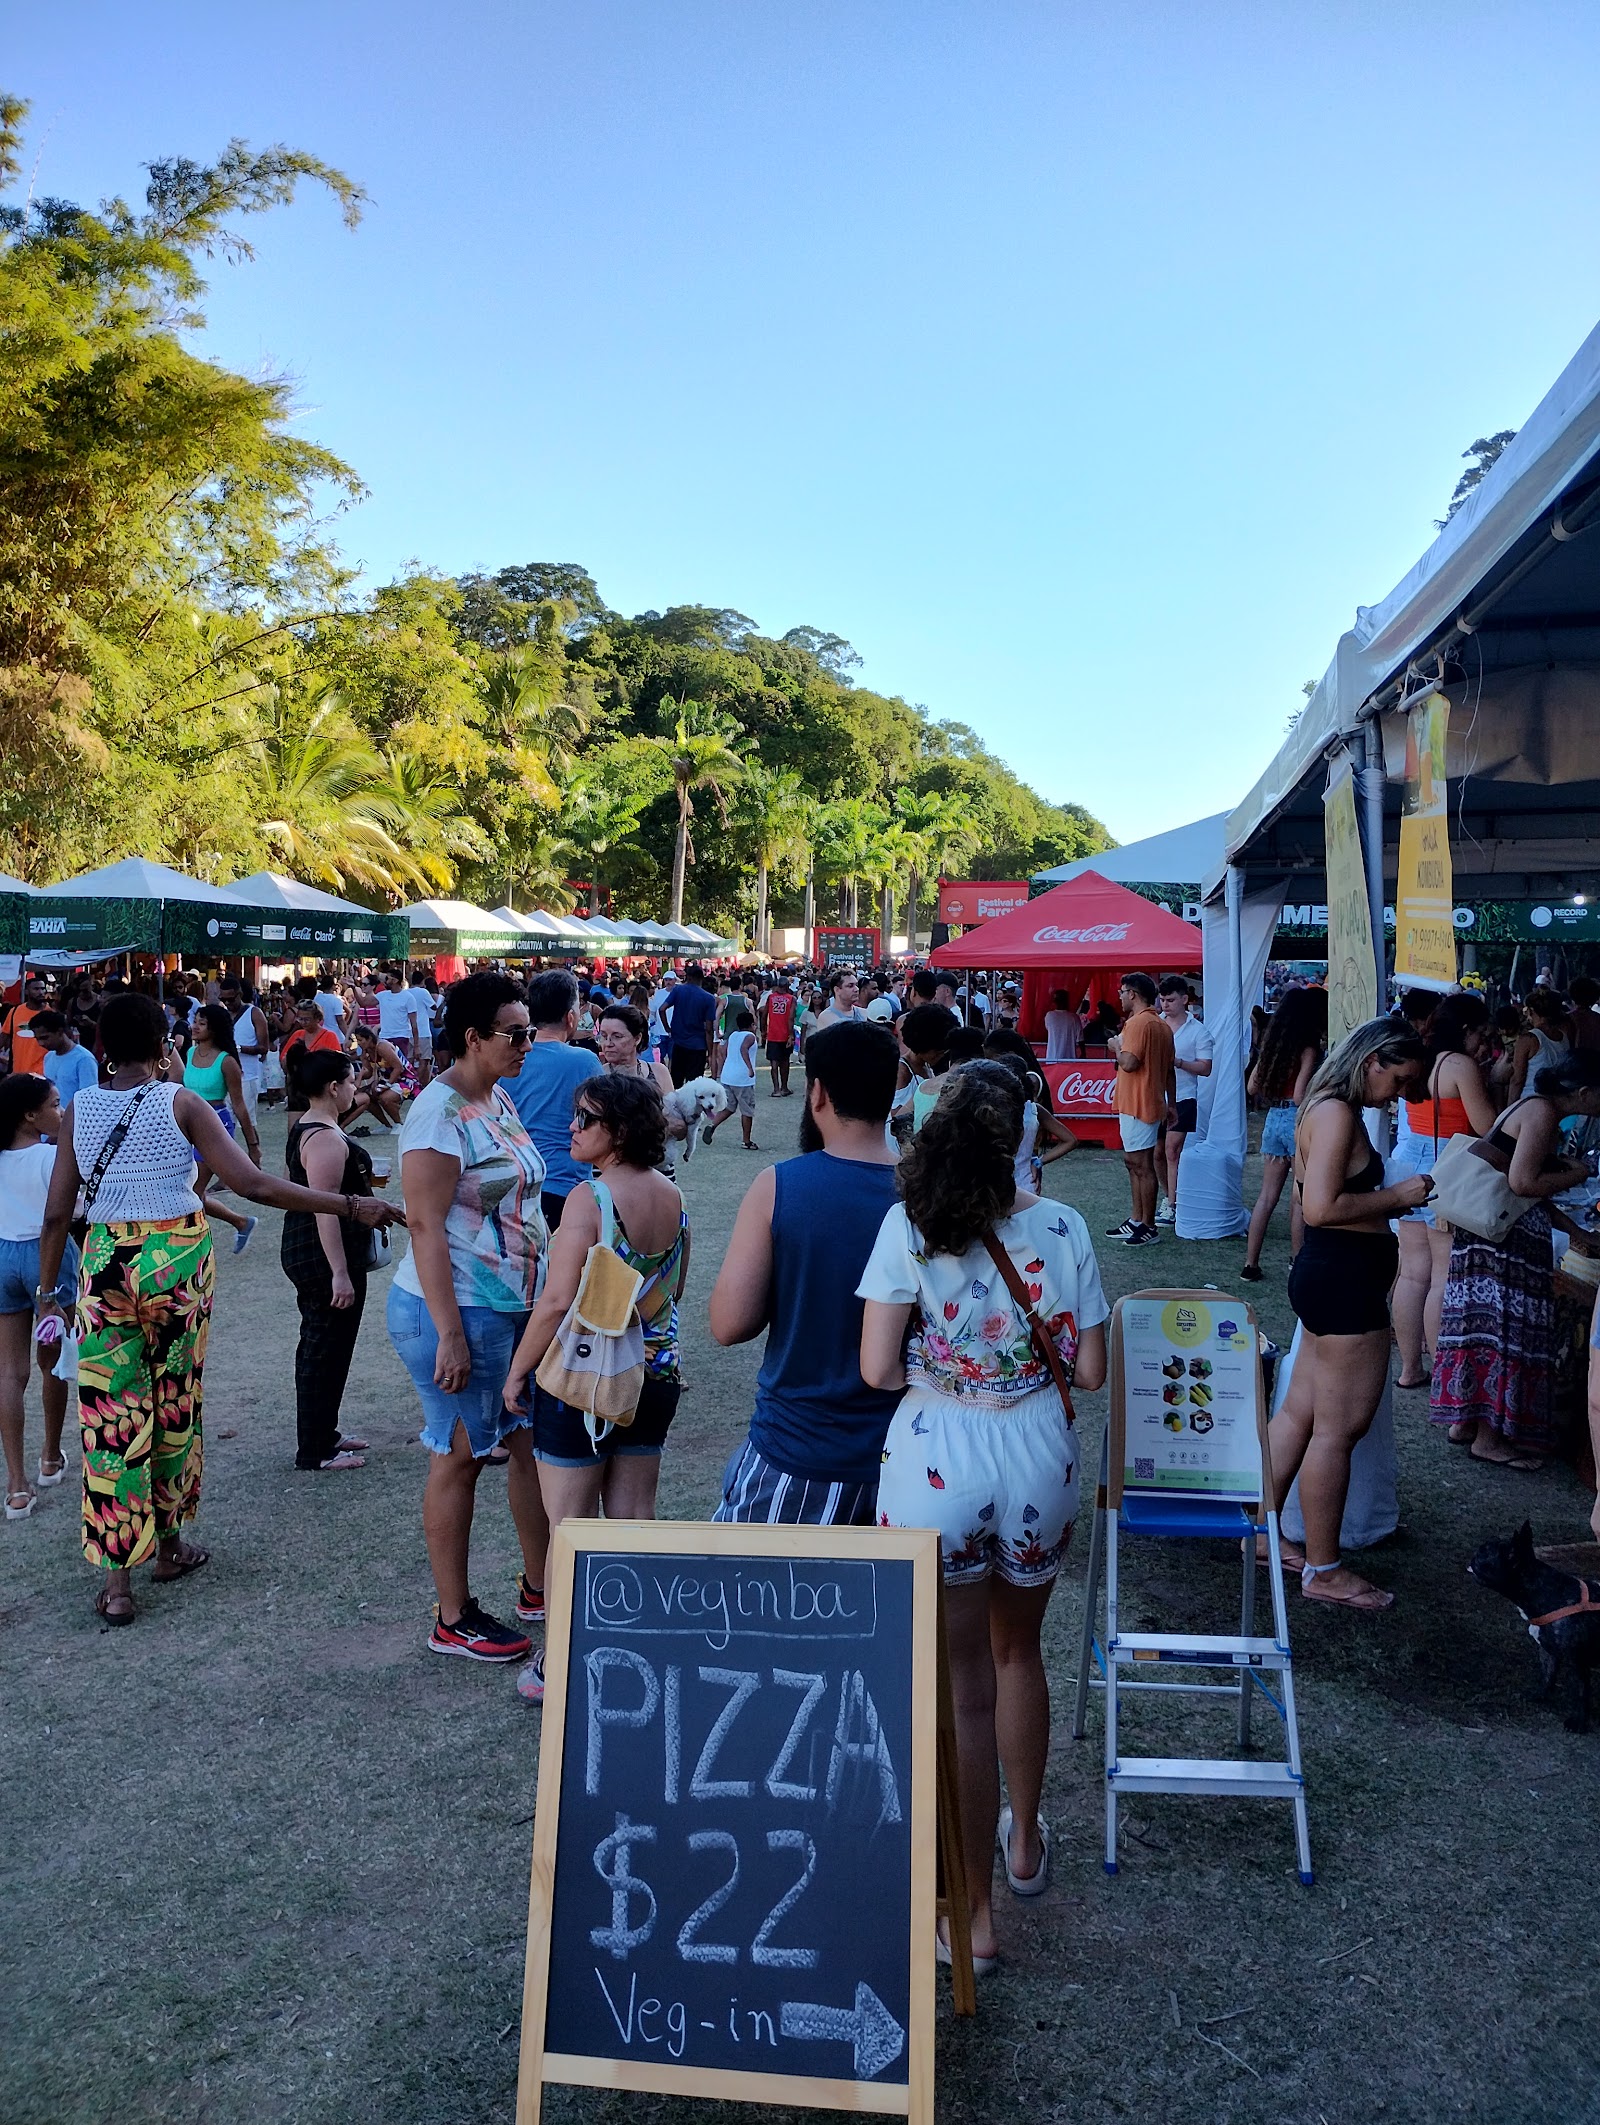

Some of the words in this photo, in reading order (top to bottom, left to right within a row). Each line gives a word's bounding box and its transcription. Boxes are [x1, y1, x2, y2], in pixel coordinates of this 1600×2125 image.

[978, 898, 1014, 907] Festival
[1554, 908, 1588, 917] RECORD
[314, 927, 335, 942] Claro
[1033, 922, 1134, 944] Coca-Cola
[772, 1001, 787, 1015] 23
[120, 1098, 140, 1127] SPORT
[97, 1144, 115, 1170] SPORT
[591, 1561, 858, 1650] @veginba
[584, 1645, 903, 1823] PIZZA
[589, 1811, 820, 1967] $22
[594, 1966, 778, 2058] Veg-in
